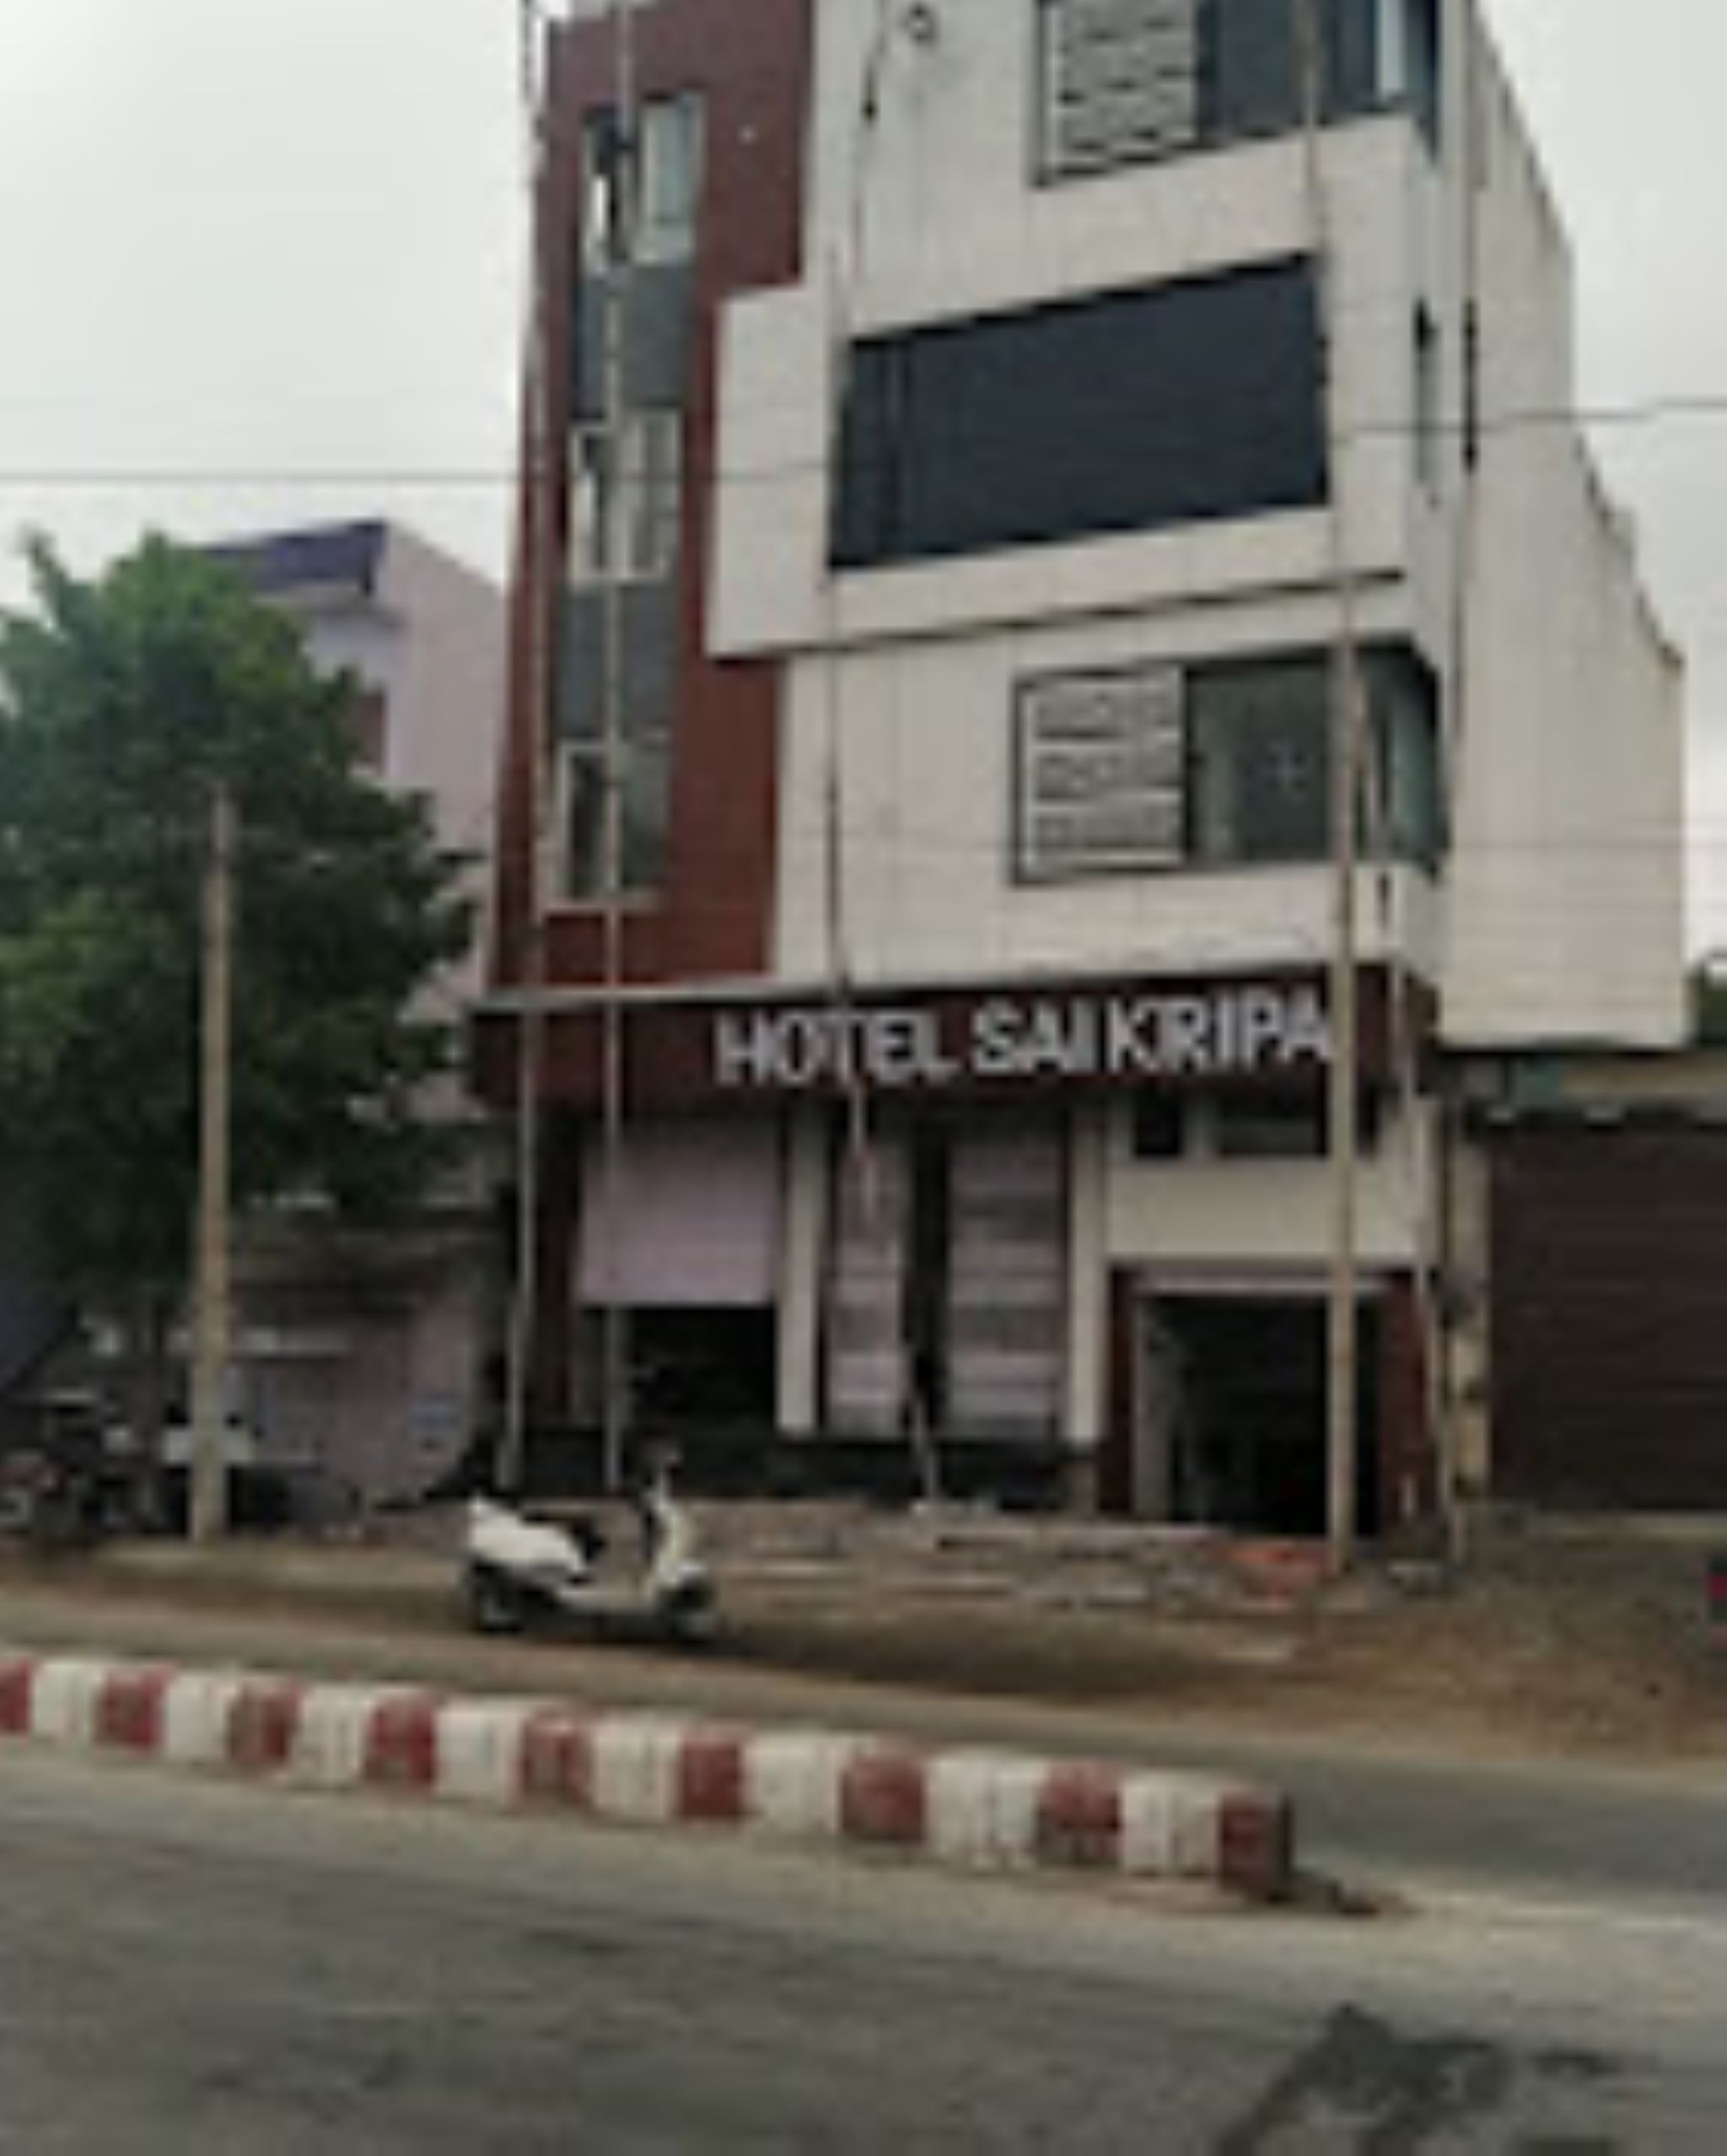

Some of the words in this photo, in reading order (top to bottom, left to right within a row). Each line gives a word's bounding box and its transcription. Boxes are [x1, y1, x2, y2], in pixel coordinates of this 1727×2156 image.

[715, 1007, 960, 1086] HOTEL
[971, 997, 1096, 1075] SAI
[1107, 985, 1333, 1073] KRIPA
